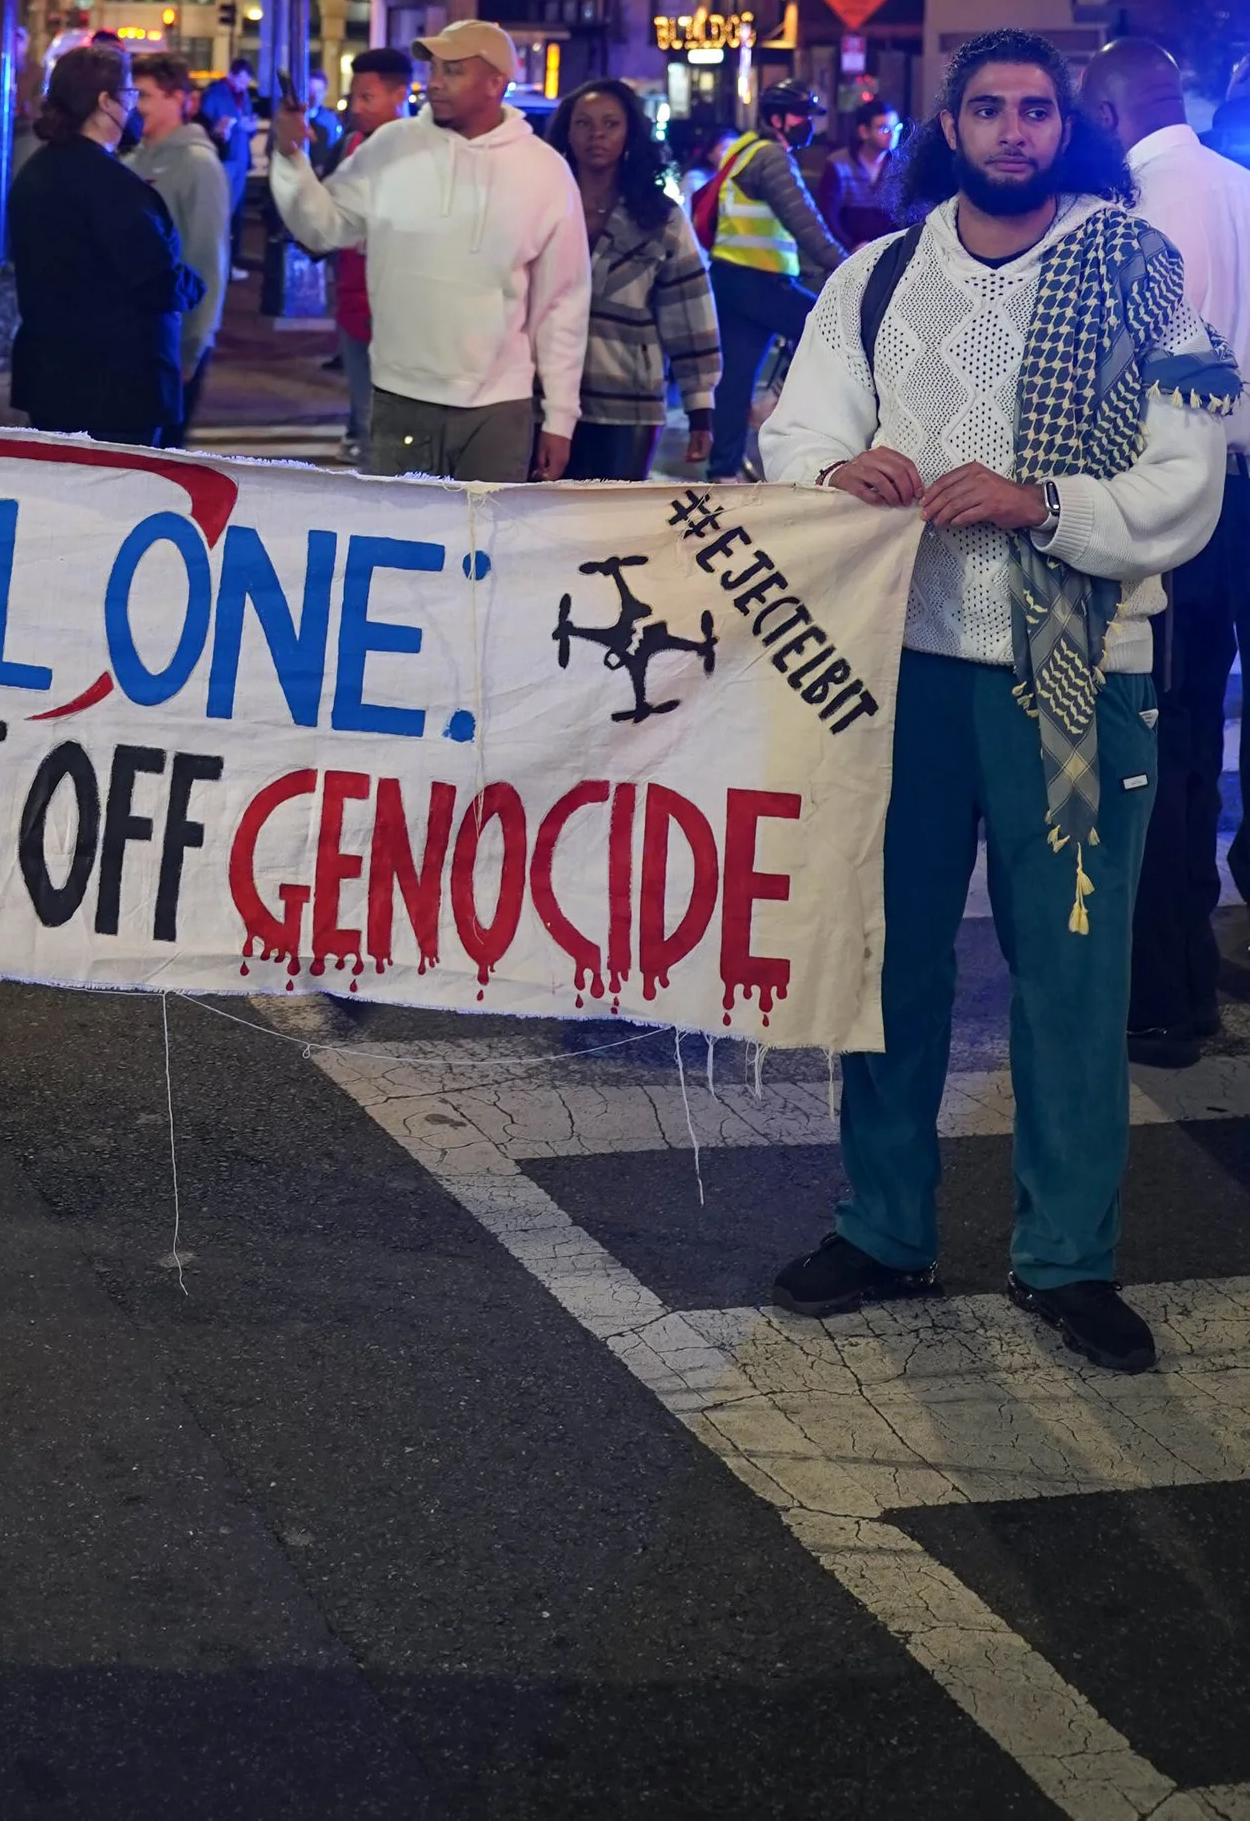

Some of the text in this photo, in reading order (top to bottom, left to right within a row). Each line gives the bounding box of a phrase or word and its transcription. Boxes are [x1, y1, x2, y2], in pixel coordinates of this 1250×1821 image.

[105, 511, 492, 742] ONE:
[668, 489, 879, 735] #EJECTELBIT
[19, 739, 224, 941] OFF
[230, 768, 802, 1009] GENOCIDE
